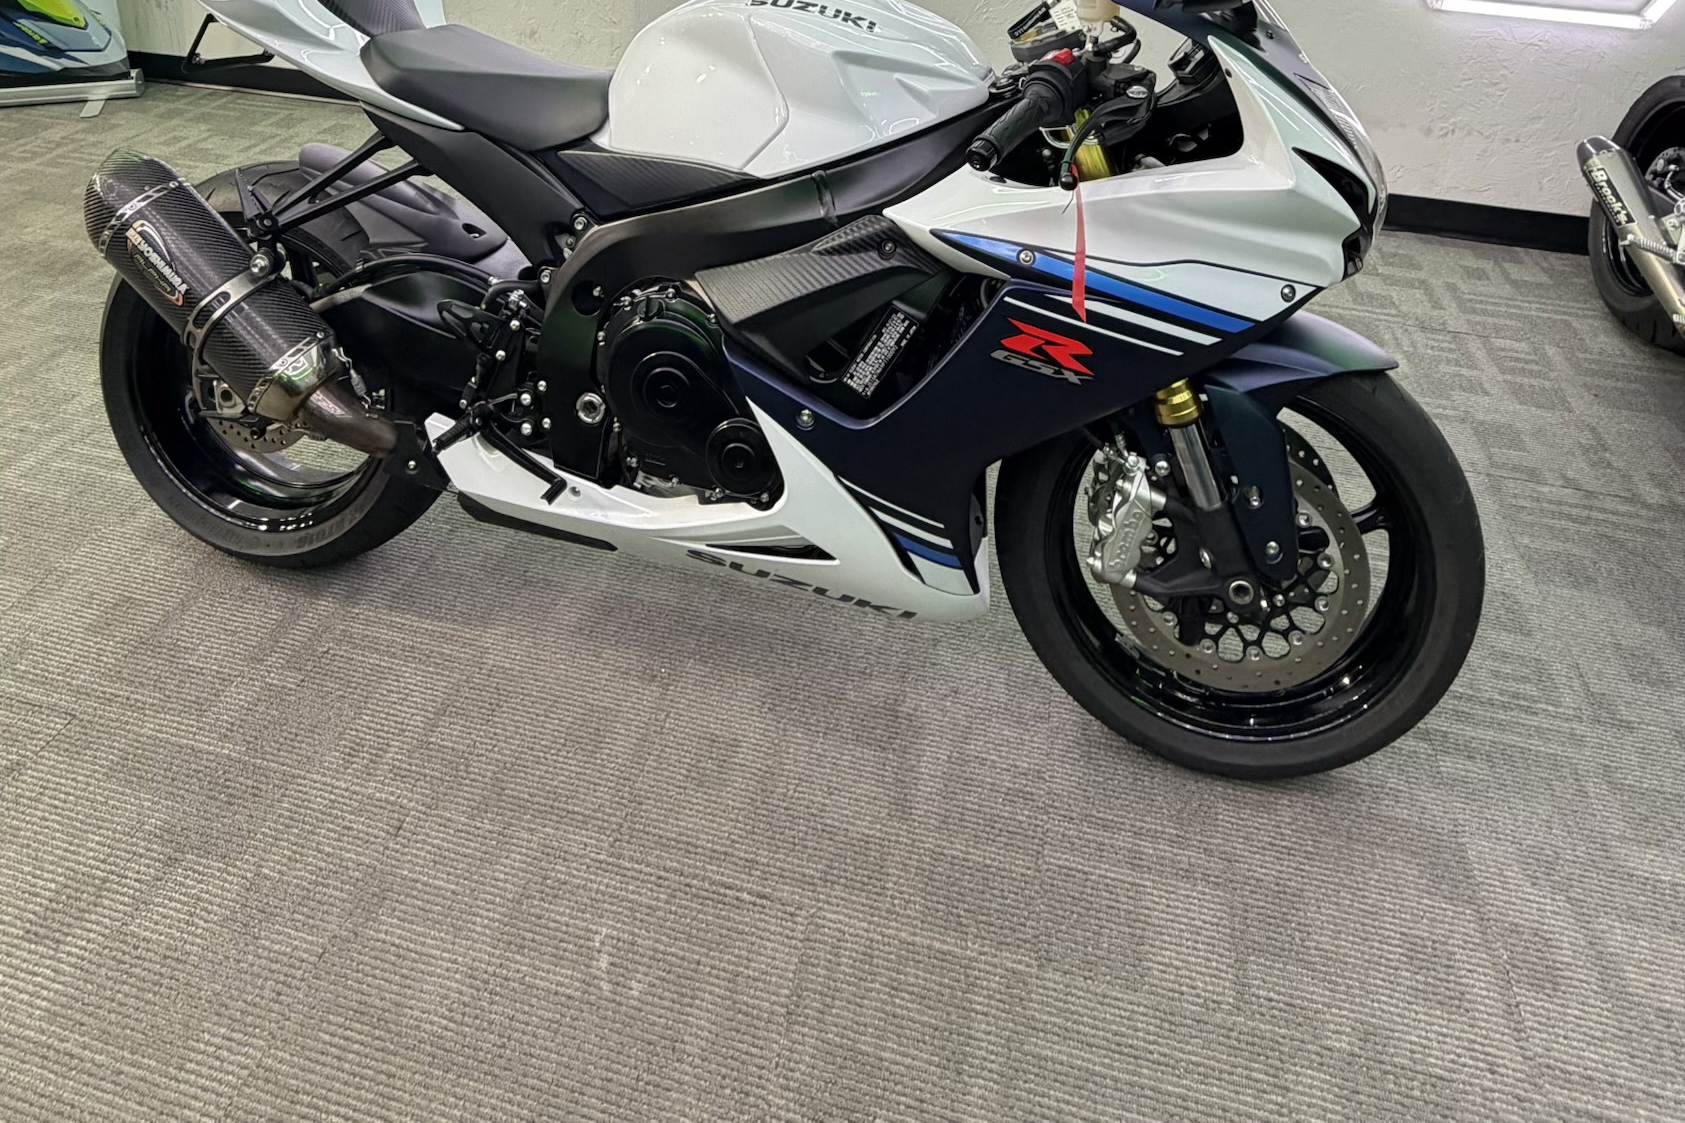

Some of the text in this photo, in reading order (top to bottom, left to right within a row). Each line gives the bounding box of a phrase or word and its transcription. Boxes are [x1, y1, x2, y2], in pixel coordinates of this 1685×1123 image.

[1591, 170, 1628, 222] Brock's
[137, 240, 187, 295] YOSHIMURA
[990, 350, 1094, 385] GSX
[686, 549, 917, 619] SUZUKI
